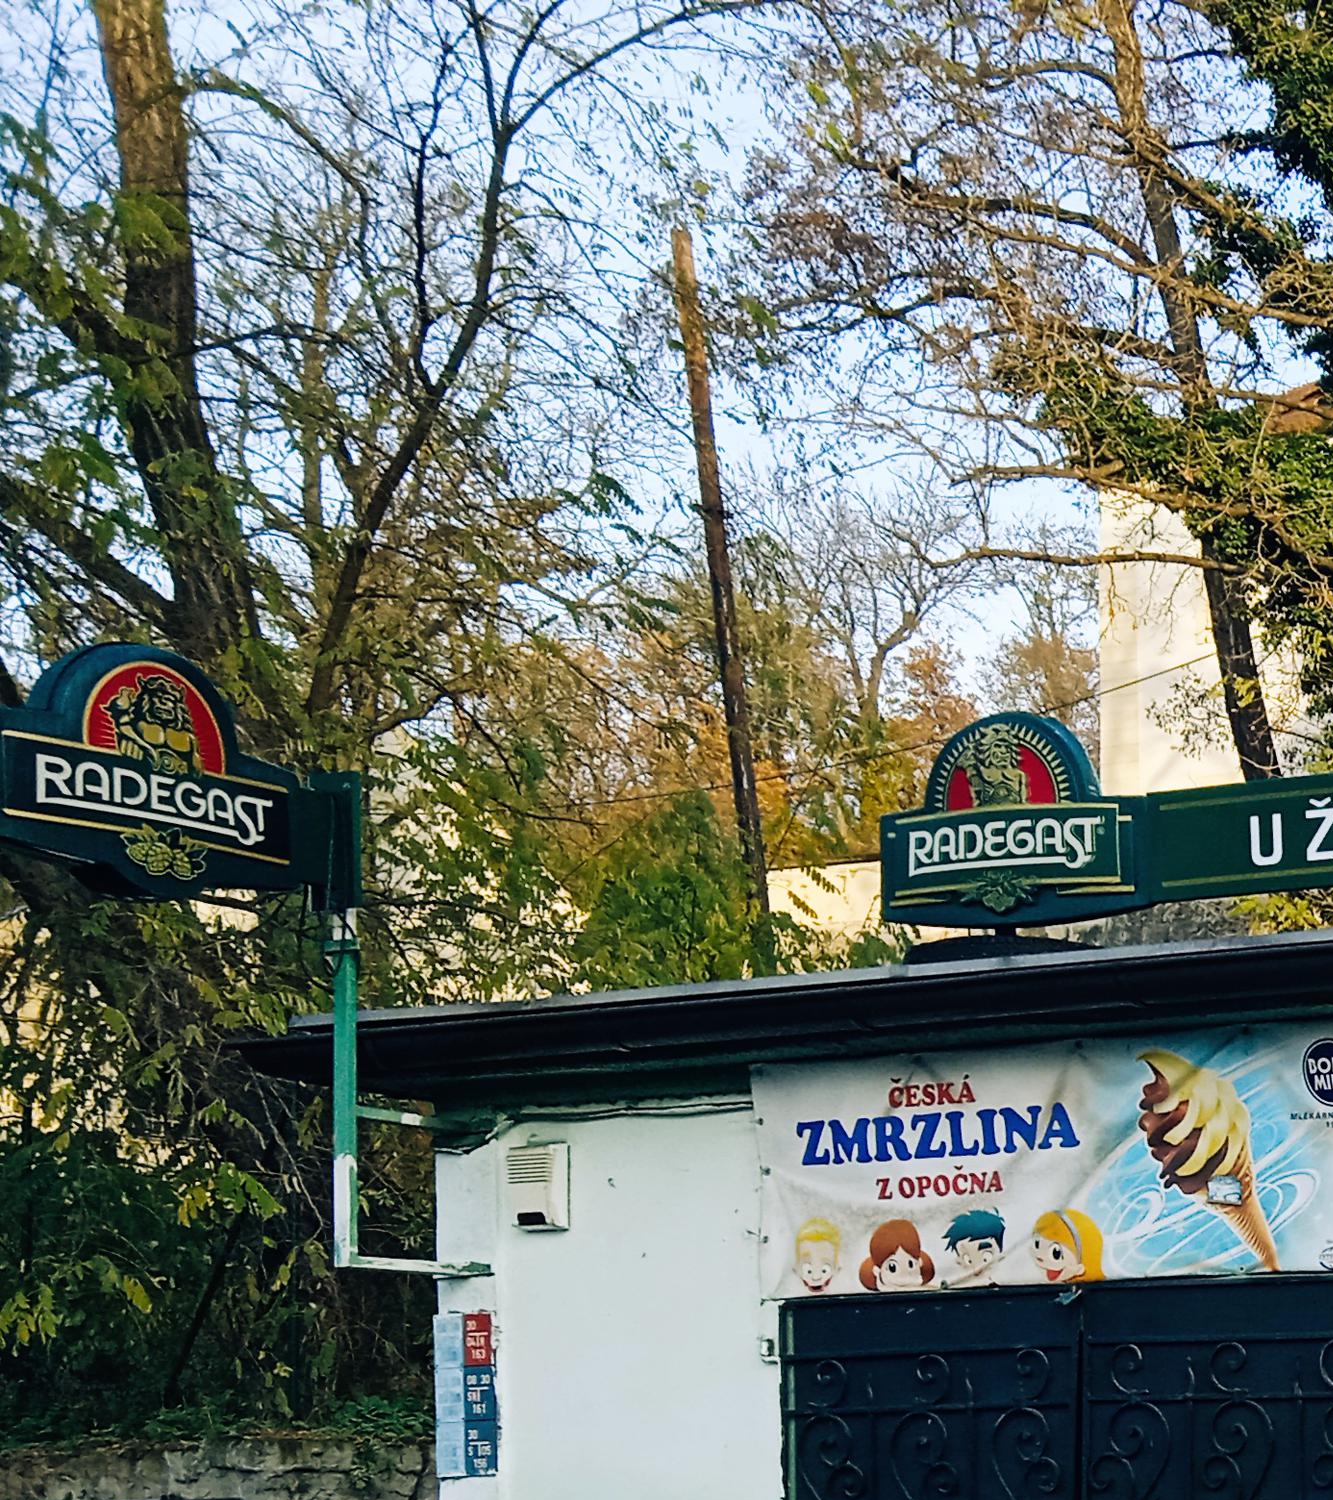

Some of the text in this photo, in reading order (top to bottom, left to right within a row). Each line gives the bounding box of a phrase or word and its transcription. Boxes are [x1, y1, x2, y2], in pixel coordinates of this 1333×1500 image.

[36, 753, 274, 846] RADEGAST
[908, 815, 1105, 877] RADEGAST
[1249, 812, 1283, 867] U
[887, 1073, 977, 1109] ČESKÁ
[796, 1101, 1081, 1166] ZMRZLINA
[875, 1165, 1004, 1201] Z OPOČNA
